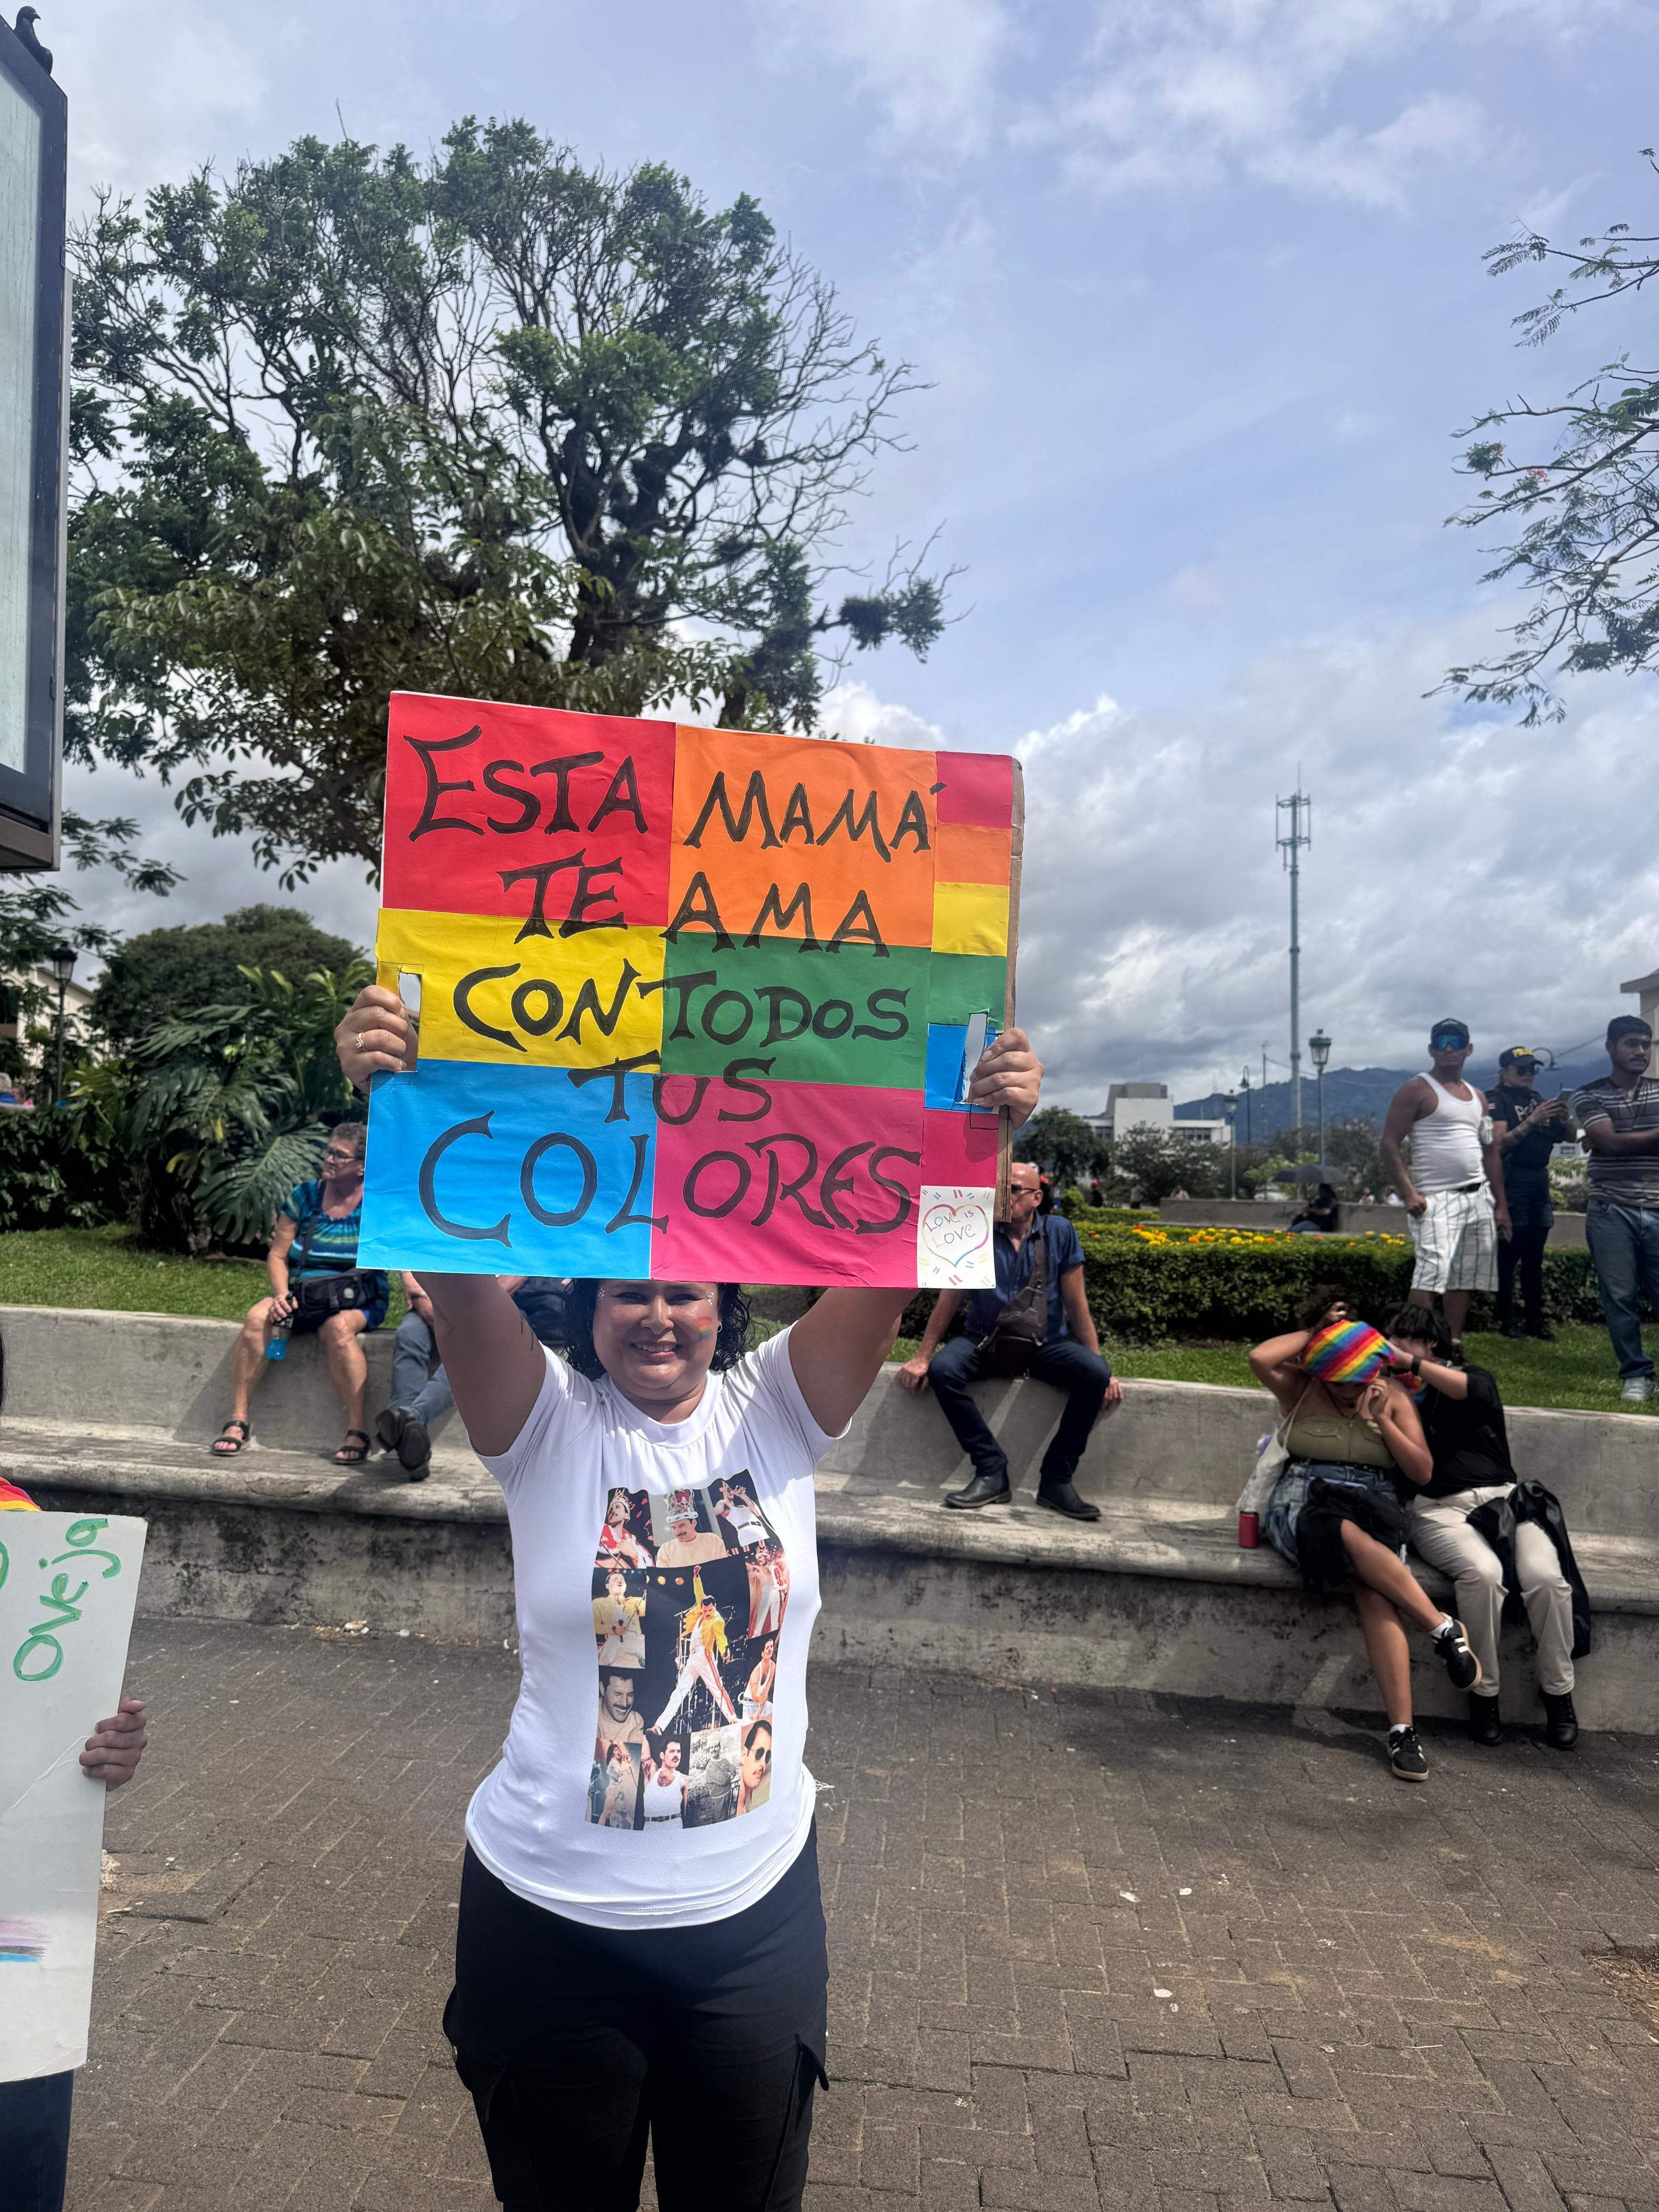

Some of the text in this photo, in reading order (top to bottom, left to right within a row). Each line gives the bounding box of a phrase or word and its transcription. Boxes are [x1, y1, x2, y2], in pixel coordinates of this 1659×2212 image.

[403, 724, 948, 863] ESTA MAMÁ
[496, 848, 891, 958] TE AMA
[453, 958, 911, 1052] CON TODOS
[566, 1049, 776, 1126] TUS
[418, 1110, 922, 1248] COLORES
[13, 1518, 122, 1682] Oveja
